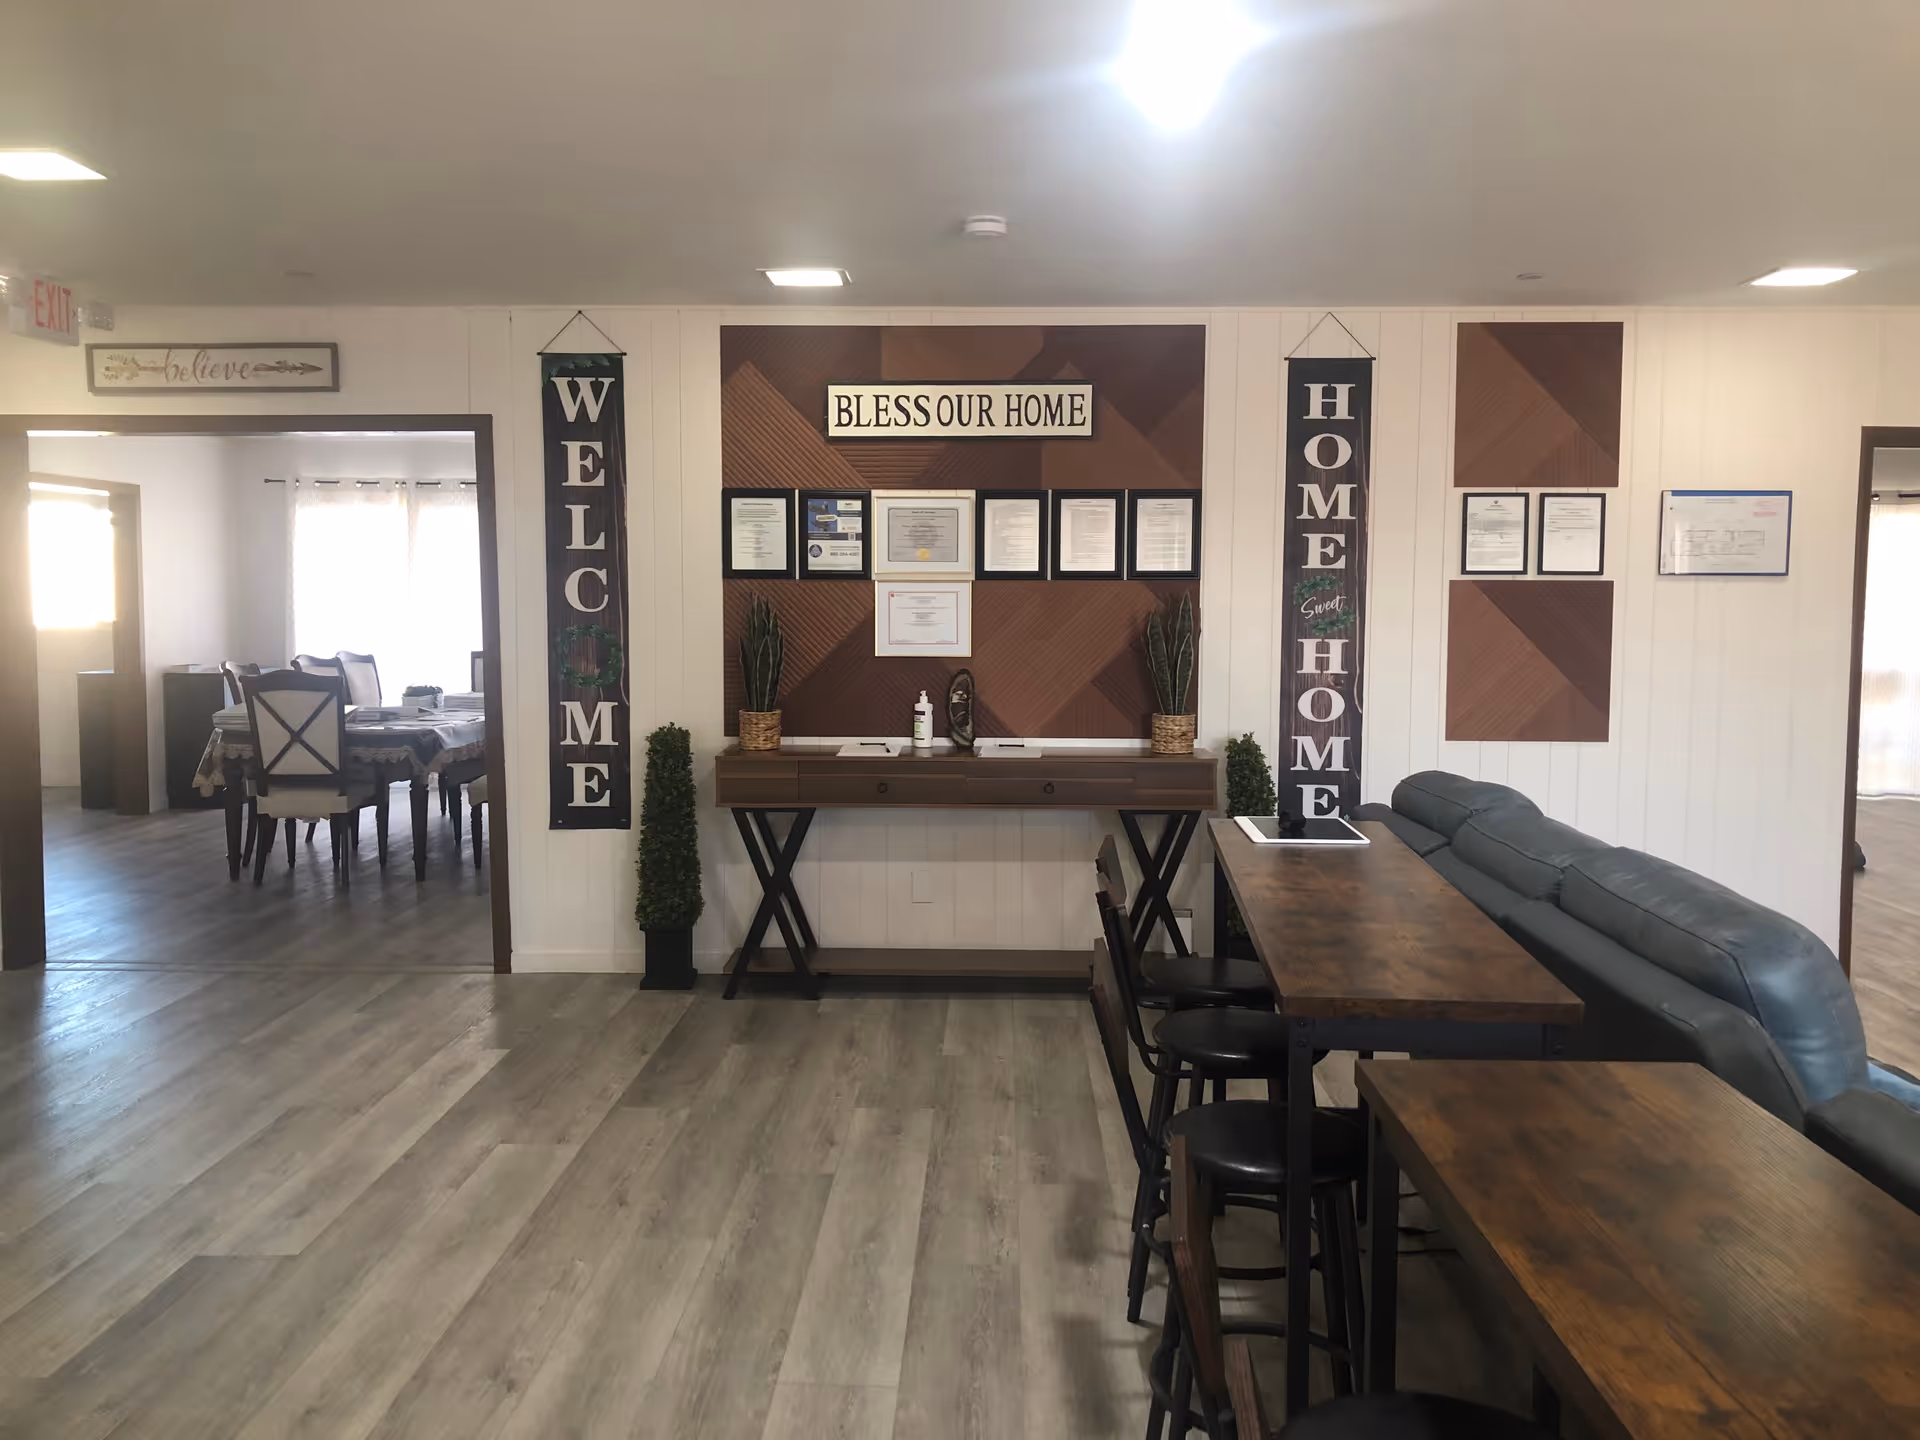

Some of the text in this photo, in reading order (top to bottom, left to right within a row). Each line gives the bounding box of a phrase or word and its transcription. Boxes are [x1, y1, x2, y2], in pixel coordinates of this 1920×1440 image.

[34, 279, 71, 336] EXIT
[163, 346, 251, 384] believe
[834, 393, 1087, 427] BLESS OUR HOME
[1296, 383, 1358, 569] HOME
[549, 376, 622, 807] WELCOME
[1300, 595, 1347, 619] Sweet
[1290, 638, 1351, 819] HOME
